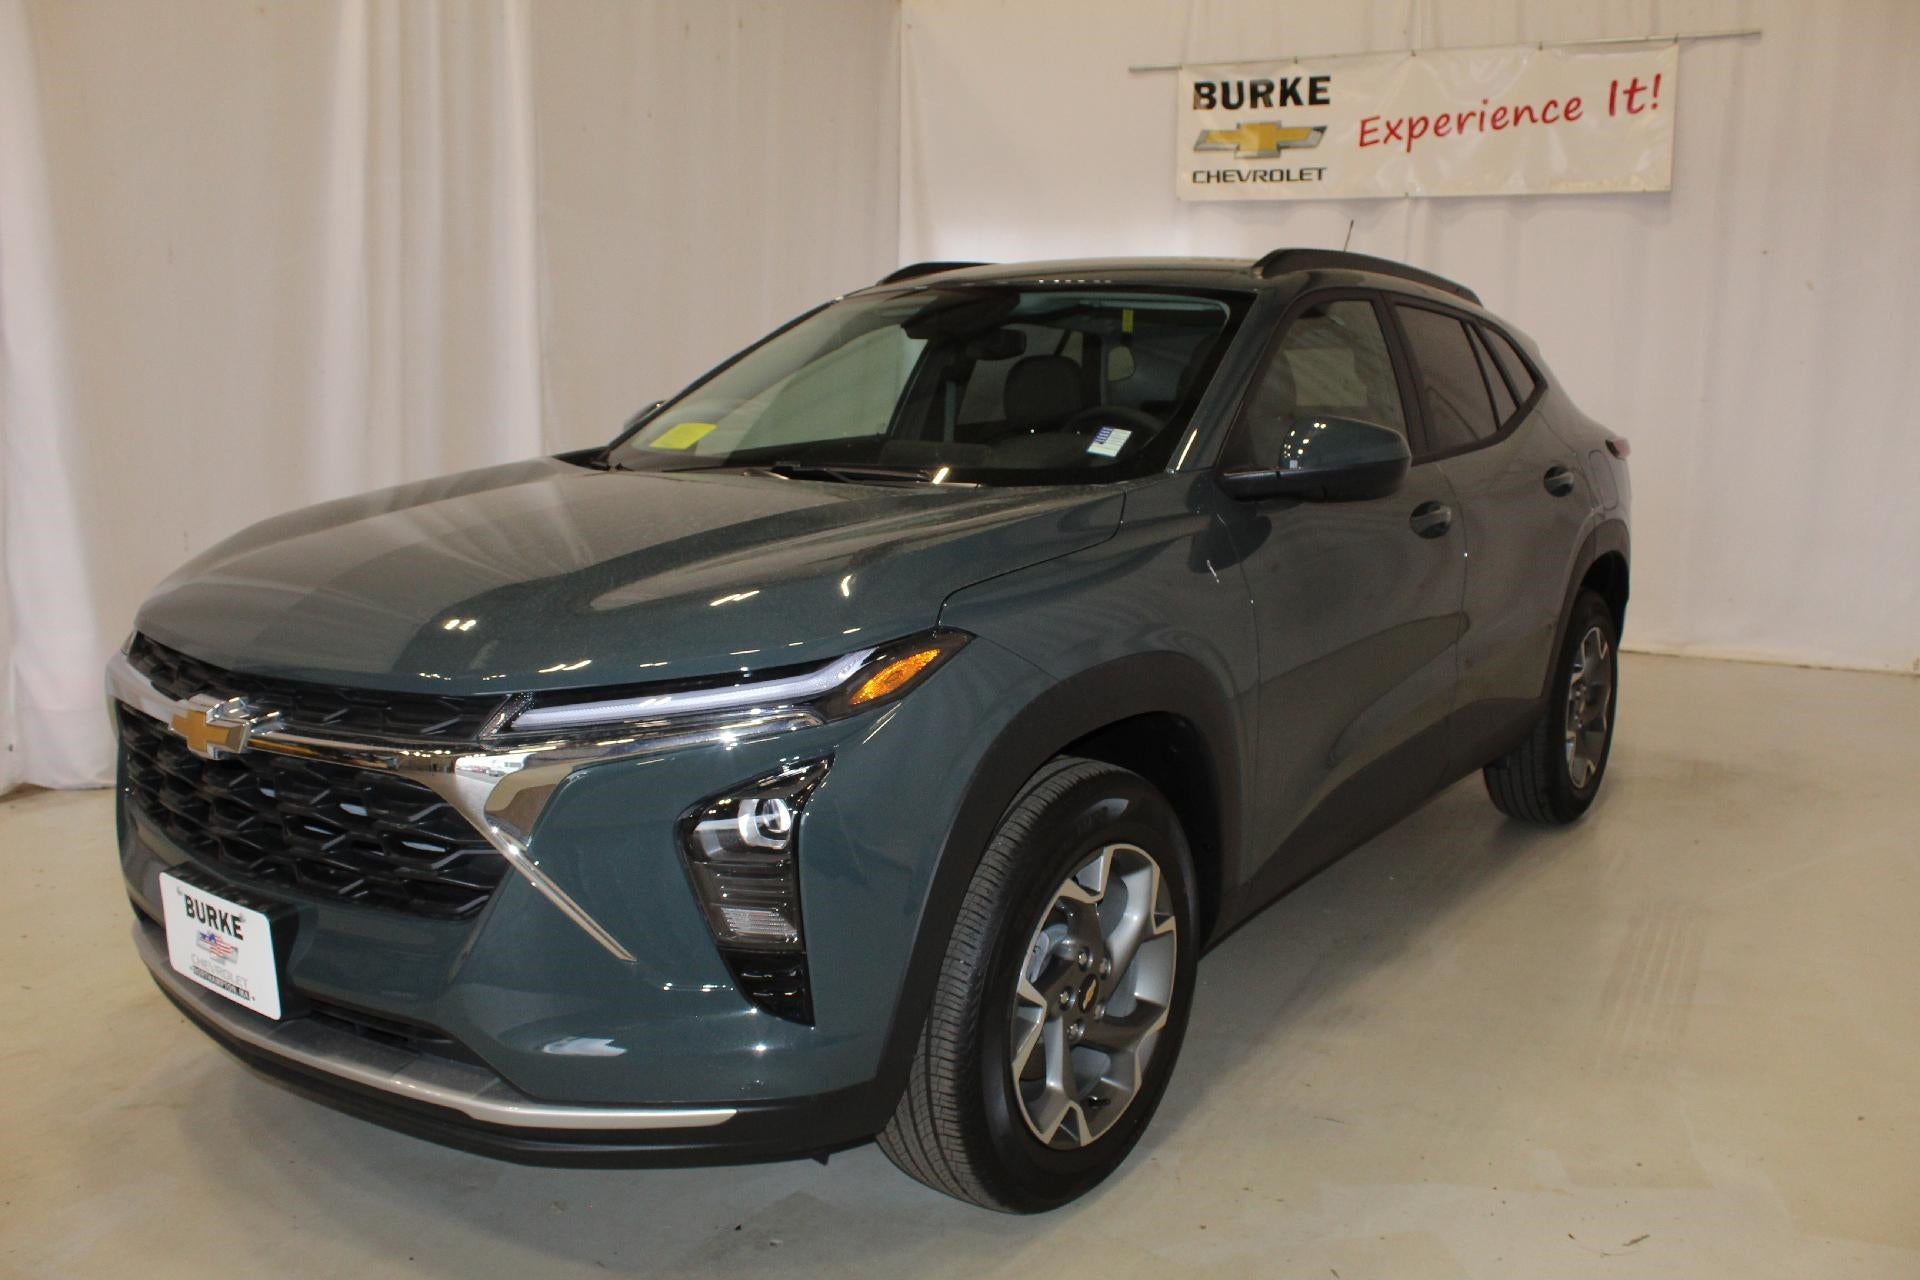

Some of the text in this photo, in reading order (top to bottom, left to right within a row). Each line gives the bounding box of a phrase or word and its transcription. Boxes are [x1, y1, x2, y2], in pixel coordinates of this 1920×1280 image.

[1193, 76, 1331, 110] BURKE
[1358, 73, 1662, 152] Experience It!
[1192, 167, 1328, 184] CHEVROLET
[184, 895, 243, 940] BURKE
